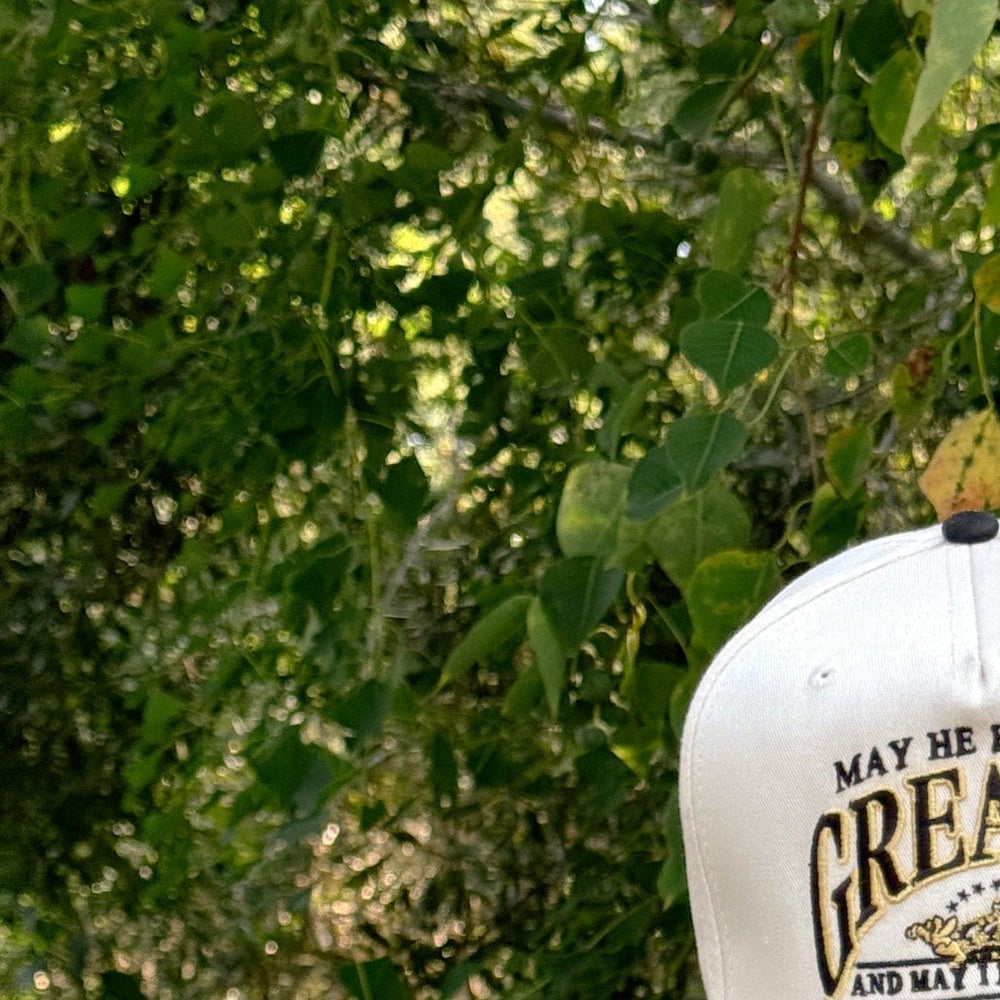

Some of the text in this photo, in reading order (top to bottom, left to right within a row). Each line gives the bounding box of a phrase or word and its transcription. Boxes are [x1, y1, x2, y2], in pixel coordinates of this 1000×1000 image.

[833, 737, 913, 793] MAY
[927, 727, 976, 760] HE
[851, 971, 903, 996] AND
[909, 965, 966, 992] MAY
[978, 961, 990, 986] I
